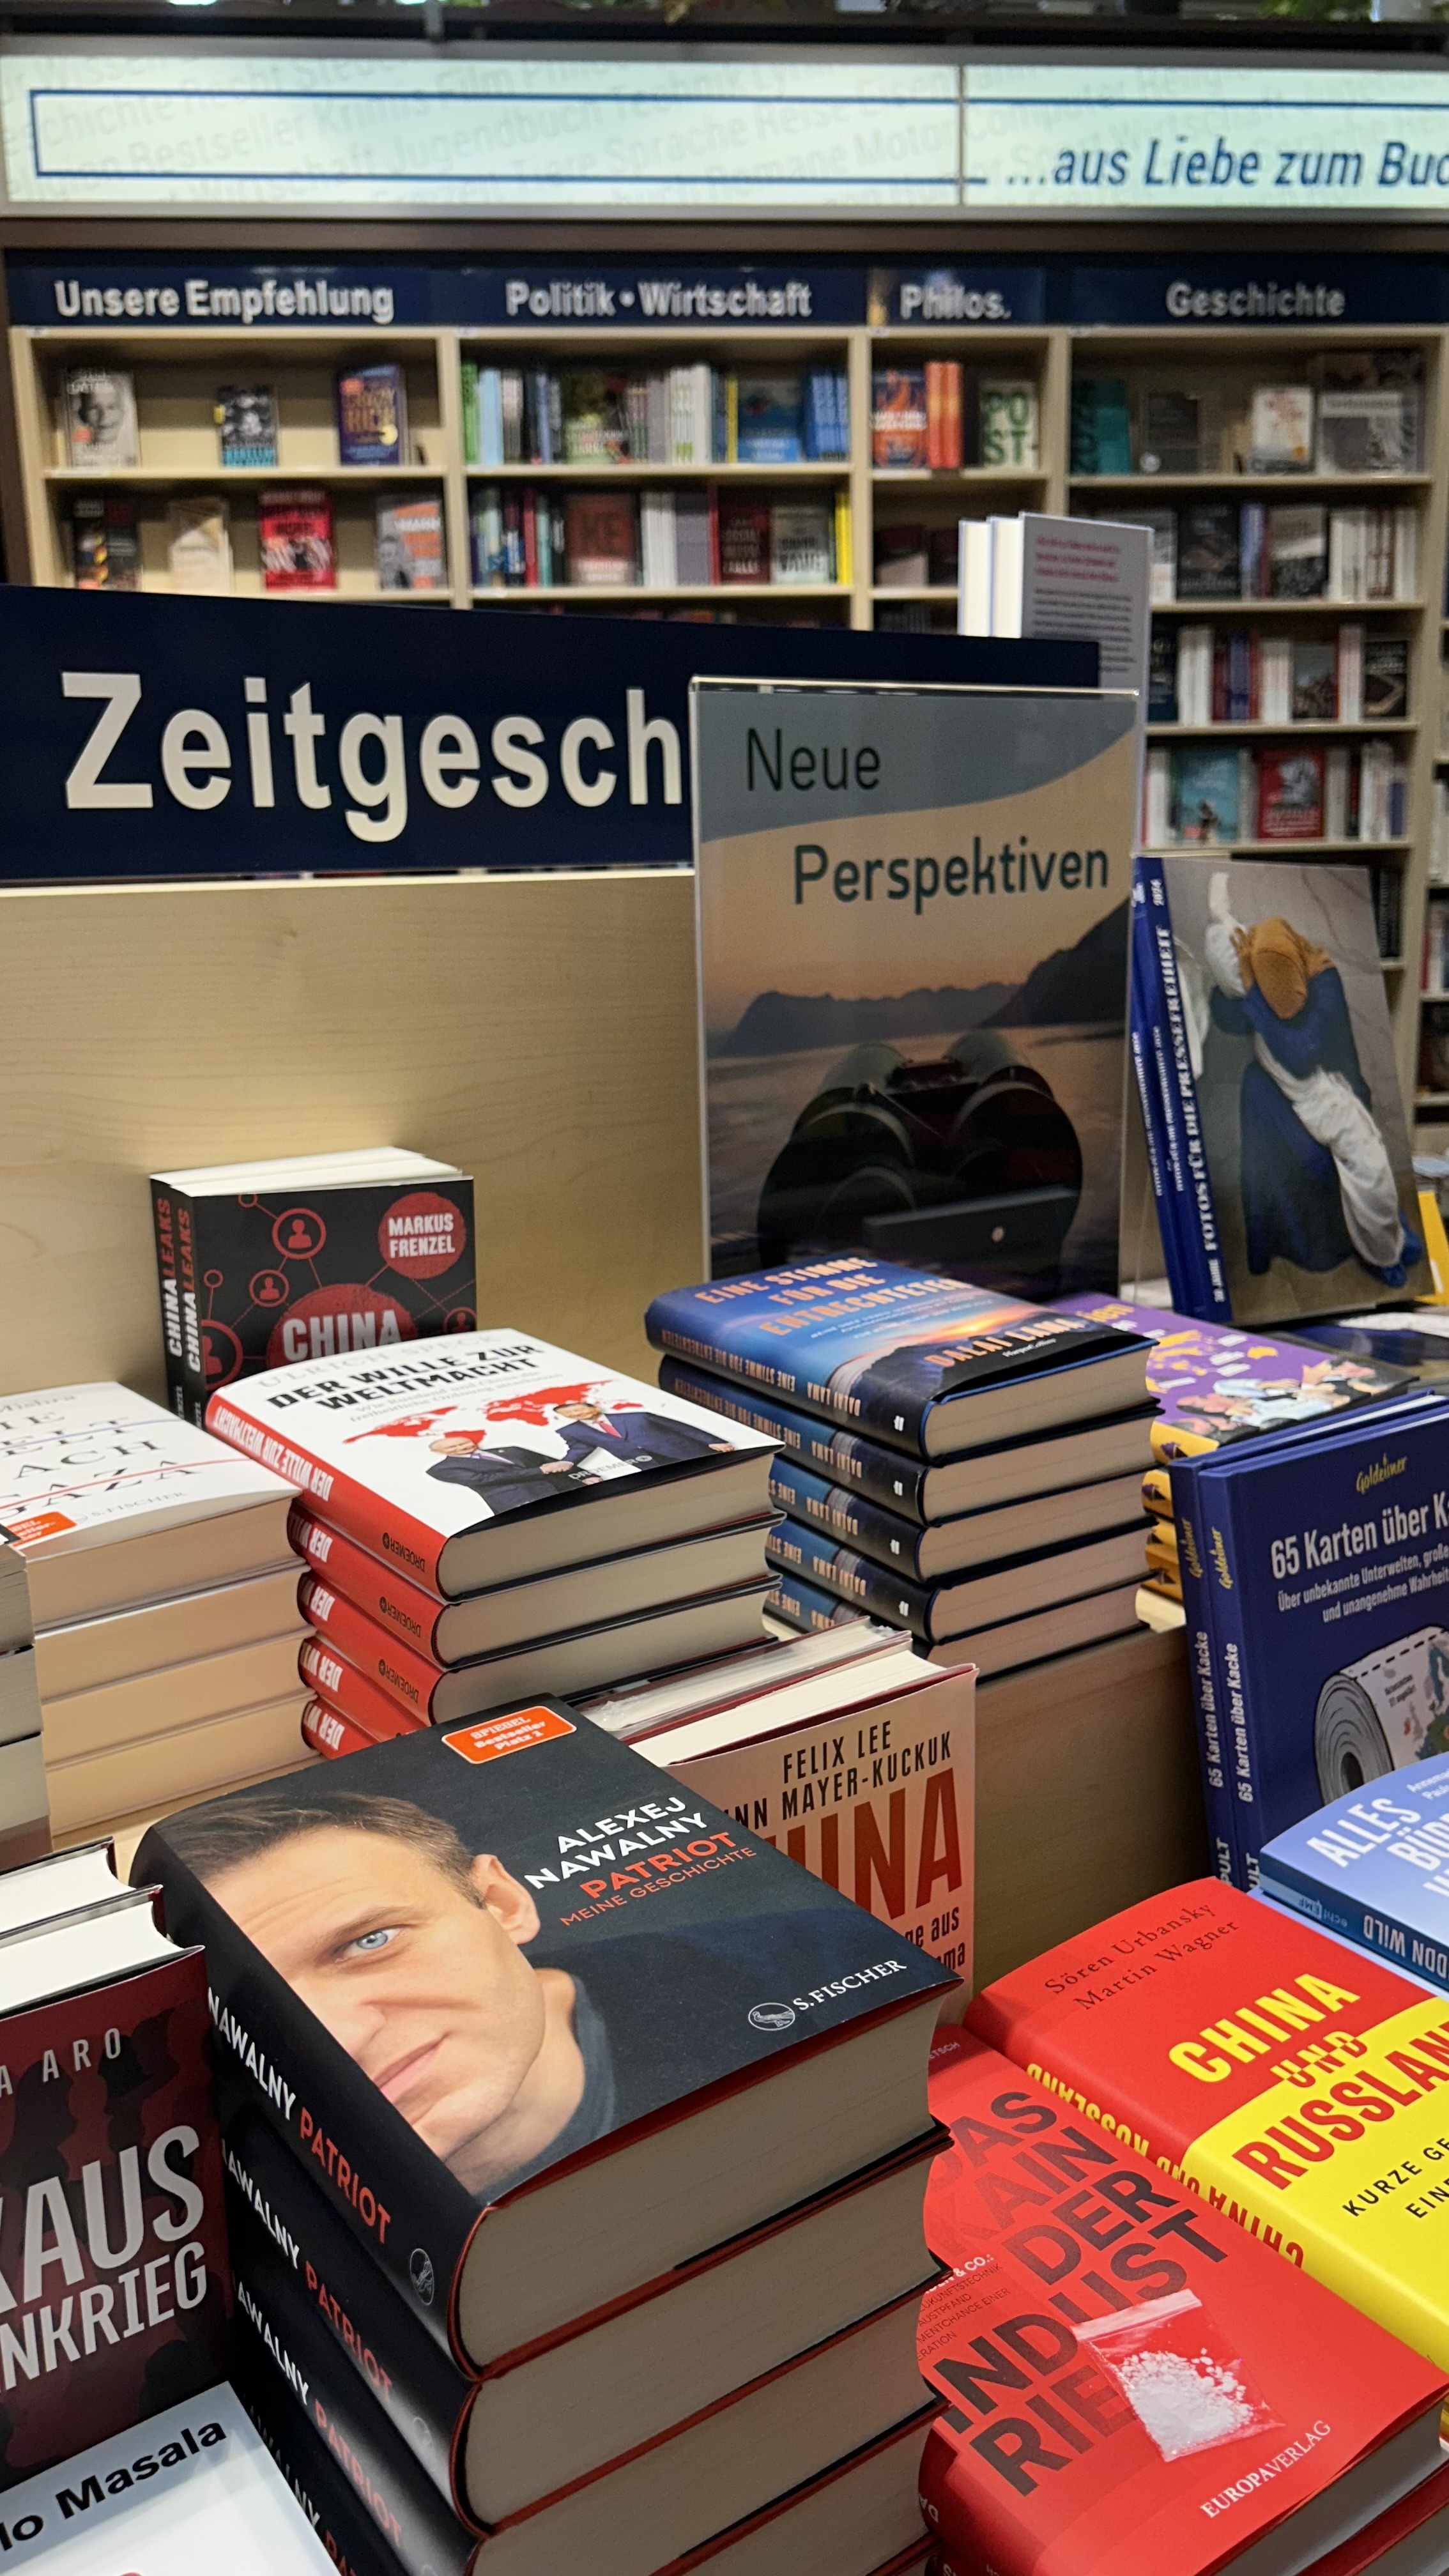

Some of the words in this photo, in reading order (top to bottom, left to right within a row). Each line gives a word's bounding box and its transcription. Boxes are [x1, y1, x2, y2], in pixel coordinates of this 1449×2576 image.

[1144, 135, 1260, 186] Liebe
[1275, 151, 1363, 187] zum
[54, 279, 180, 317] Unsere
[185, 279, 395, 324] Empfehlung
[505, 279, 616, 317] Politik
[638, 279, 812, 318] Wirtschaft
[900, 283, 1012, 319] Philos.
[1166, 280, 1346, 318] Geschichte
[61, 670, 683, 843] Zeitgesch
[747, 727, 881, 792] Neue
[793, 835, 1108, 915] Perspektiven
[1155, 924, 1194, 1098] PRESSEFREIHEIT
[1181, 1100, 1199, 1135] DIE
[1186, 1138, 1205, 1179] FÜR
[388, 1213, 454, 1237] MARKUS
[1194, 1184, 1218, 1251] FOTOS
[389, 1235, 456, 1259] FRENZEL
[695, 1280, 769, 1304] EINE
[765, 1257, 878, 1285] STIMME
[825, 1273, 885, 1291] DIE
[282, 1309, 402, 1362] CHINA
[924, 1336, 1013, 1368] DALAI
[1006, 1318, 1085, 1342] LAMA
[266, 1380, 348, 1409] DER
[351, 1355, 465, 1383] WILLE
[466, 1345, 546, 1361] ZUR
[318, 1358, 540, 1412] WELTMACHT
[778, 1370, 795, 1392] EINE
[213, 1405, 264, 1454] WELTMACHT
[263, 1436, 285, 1469] ZUR
[281, 1448, 313, 1488] WILLE
[310, 1466, 334, 1501] DER
[309, 1528, 333, 1563] DER
[390, 1534, 425, 1572] DROEMER
[1271, 1535, 1300, 1580] 65
[1305, 1522, 1378, 1570] Karten
[1382, 1505, 1429, 1545] über
[310, 1586, 335, 1621] DER
[1277, 1590, 1301, 1612] Über
[1303, 1572, 1360, 1604] unbekannte
[1322, 1601, 1341, 1623] und
[1343, 1583, 1408, 1616] unangenehme
[387, 1598, 421, 1638] DROEMER
[319, 1655, 343, 1692] DER
[1193, 1630, 1209, 1678] Kacke
[1225, 1643, 1239, 1690] Kacke
[385, 1664, 419, 1704] DROEMER
[1200, 1678, 1217, 1714] über
[1229, 1690, 1246, 1726] über
[319, 1713, 345, 1751] DER
[471, 1717, 532, 1740] SPIEGEL
[473, 1721, 546, 1749] Bestseller
[494, 1733, 533, 1750] Platz
[783, 1736, 845, 1784] FELIX
[857, 1720, 892, 1761] LEE
[1204, 1715, 1221, 1764] Karten
[1234, 1727, 1250, 1778] Karten
[782, 1731, 952, 1821] MAYER-KUCKUK
[1209, 1767, 1223, 1787] 65
[1238, 1781, 1254, 1803] 65
[558, 1796, 687, 1853] ALEXEJ
[1307, 1798, 1422, 1868] ALLES
[524, 1813, 708, 1889] NAWALNY
[579, 1832, 738, 1899] PATRIOT
[560, 1895, 628, 1927] MEINE
[629, 1847, 757, 1900] GESCHICHTE
[932, 1907, 960, 1942] aus
[1044, 1952, 1114, 1995] Sören
[1112, 1901, 1217, 1955] Urbansky
[1363, 1914, 1406, 1957] WILD
[793, 1959, 907, 2011] S.FISCHER
[1073, 1963, 1158, 2011] Martin
[1154, 1919, 1241, 1965] Wagner
[1168, 1973, 1361, 2083] CHINA
[42, 2028, 121, 2083] ARO
[1269, 2030, 1369, 2089] UND
[208, 1986, 296, 2120] NAWALNY
[300, 2108, 392, 2244] PATRIOT
[1231, 2021, 1449, 2191] RUSSLAN
[928, 2090, 1057, 2189] DAS
[1342, 2160, 1423, 2218] KURZE
[1002, 2170, 1181, 2286] DER
[981, 2288, 1011, 2306] EINER
[305, 2260, 393, 2404] PATRIOT
[968, 2364, 1138, 2497] RIE
[56, 2422, 227, 2519] Masala
[314, 2398, 402, 2549] PATRIOT
[1200, 2419, 1332, 2518] EUROPAVERLAG
